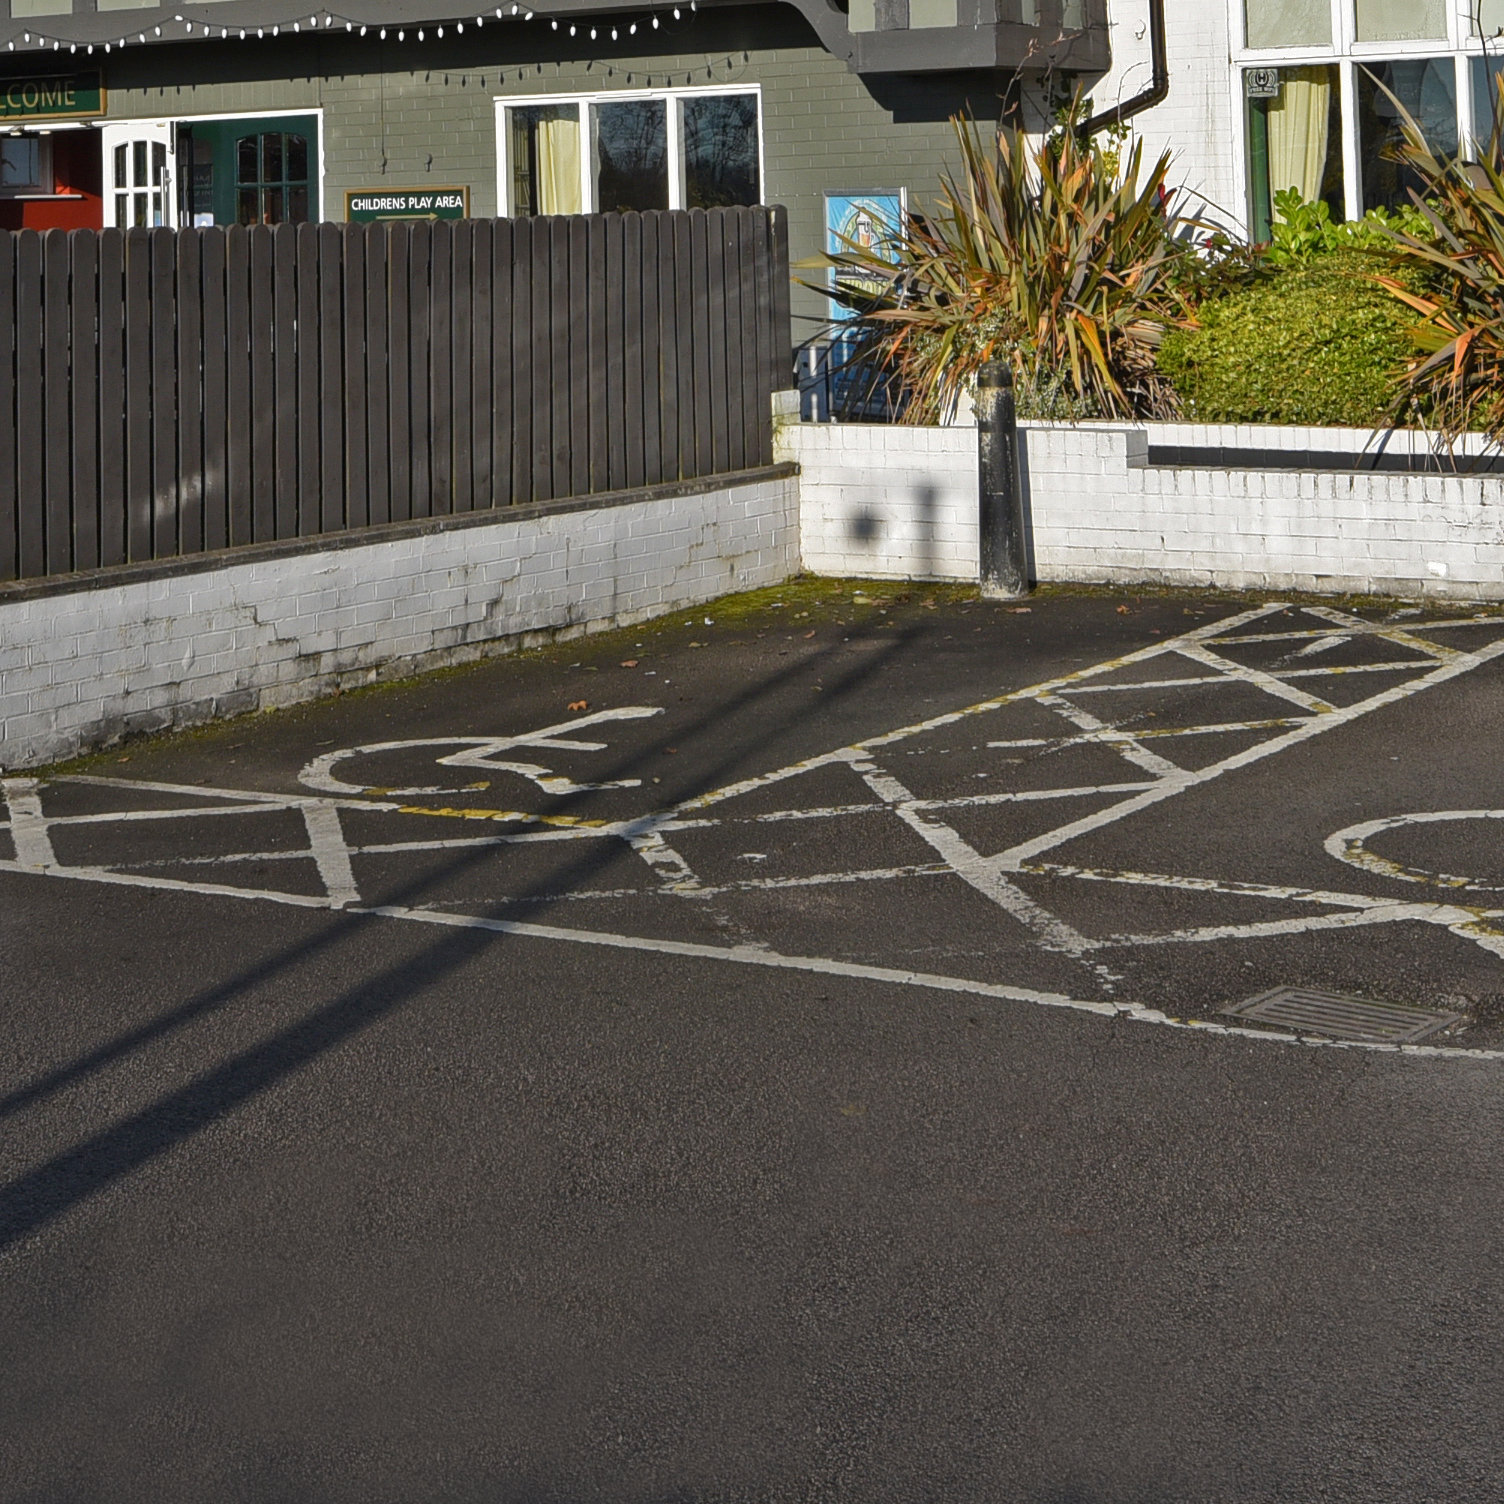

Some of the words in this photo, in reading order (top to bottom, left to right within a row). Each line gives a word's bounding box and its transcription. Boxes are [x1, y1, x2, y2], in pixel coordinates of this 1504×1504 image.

[351, 197, 406, 211] CHILDRENS
[408, 196, 433, 209] PLAY
[435, 195, 463, 208] AREA
